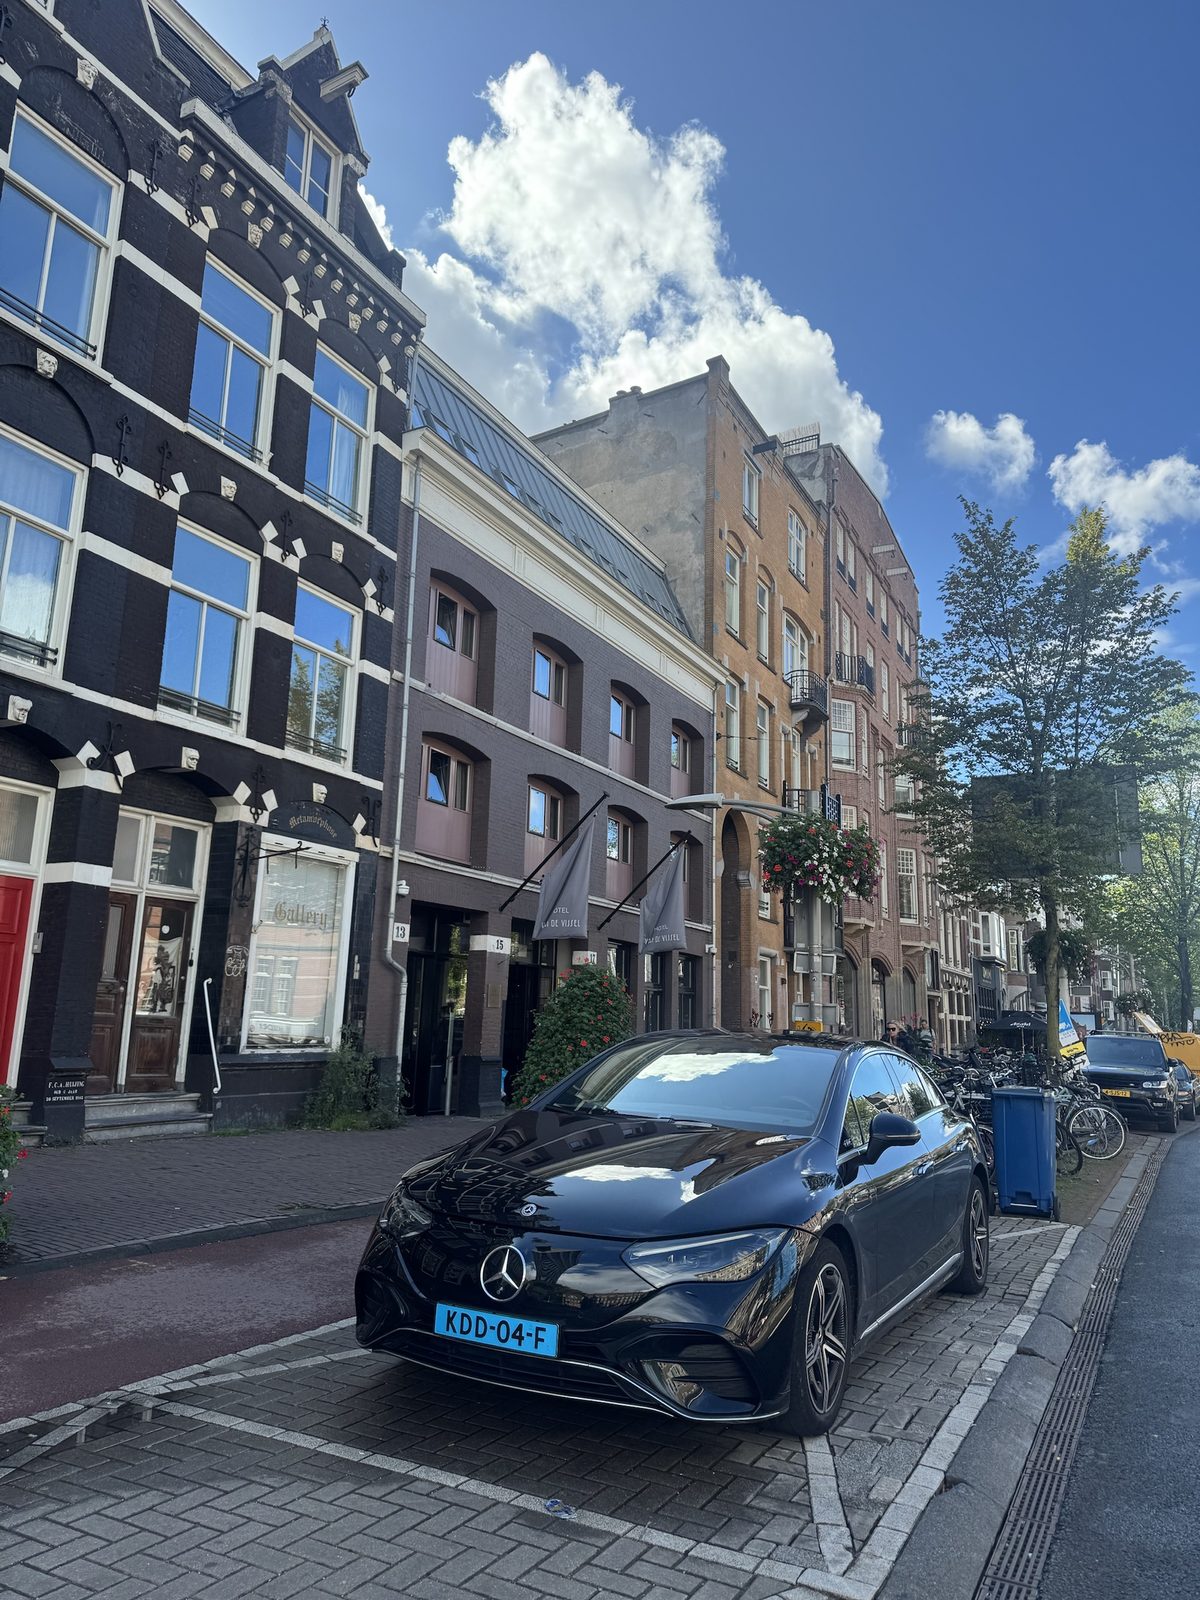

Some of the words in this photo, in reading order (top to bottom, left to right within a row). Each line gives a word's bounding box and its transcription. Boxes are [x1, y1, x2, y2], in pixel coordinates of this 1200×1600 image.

[274, 901, 327, 930] Gallery
[395, 925, 406, 939] 13
[496, 939, 504, 951] 15
[445, 1309, 547, 1350] KDD-04-F
